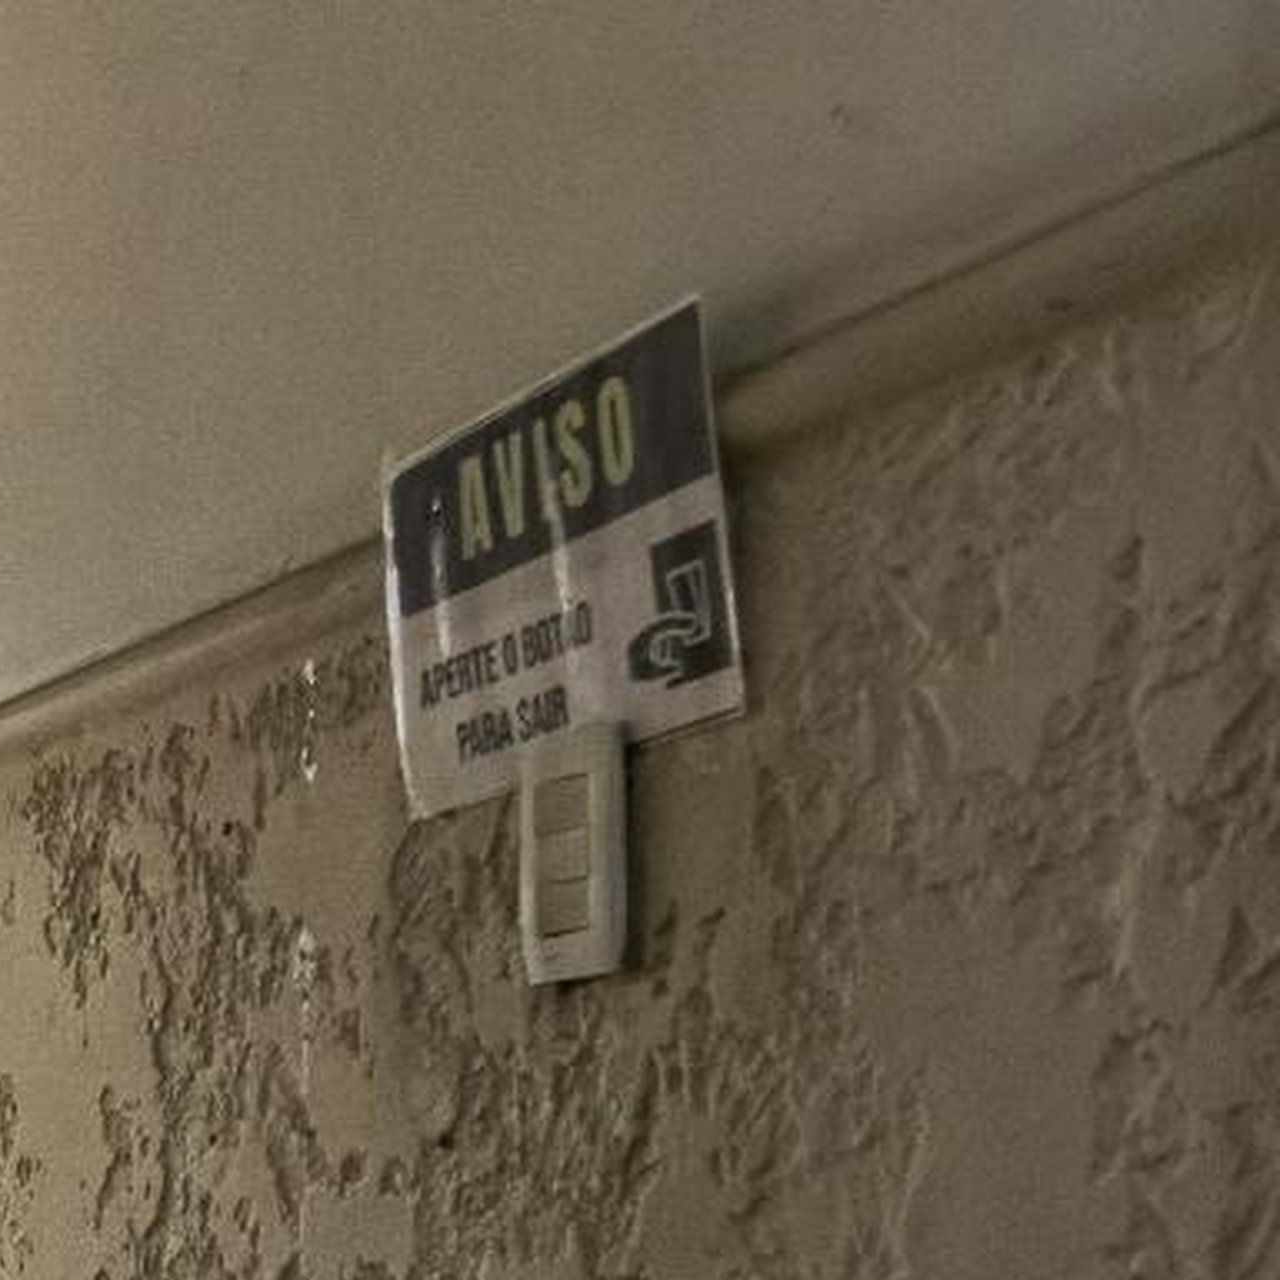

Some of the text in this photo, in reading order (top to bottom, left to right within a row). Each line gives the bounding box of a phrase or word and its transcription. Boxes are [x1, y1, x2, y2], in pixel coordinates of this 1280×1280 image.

[458, 376, 636, 560] AVISO
[420, 641, 500, 710] APERTE
[503, 633, 519, 675] O
[456, 684, 571, 764] PARA SAIR
